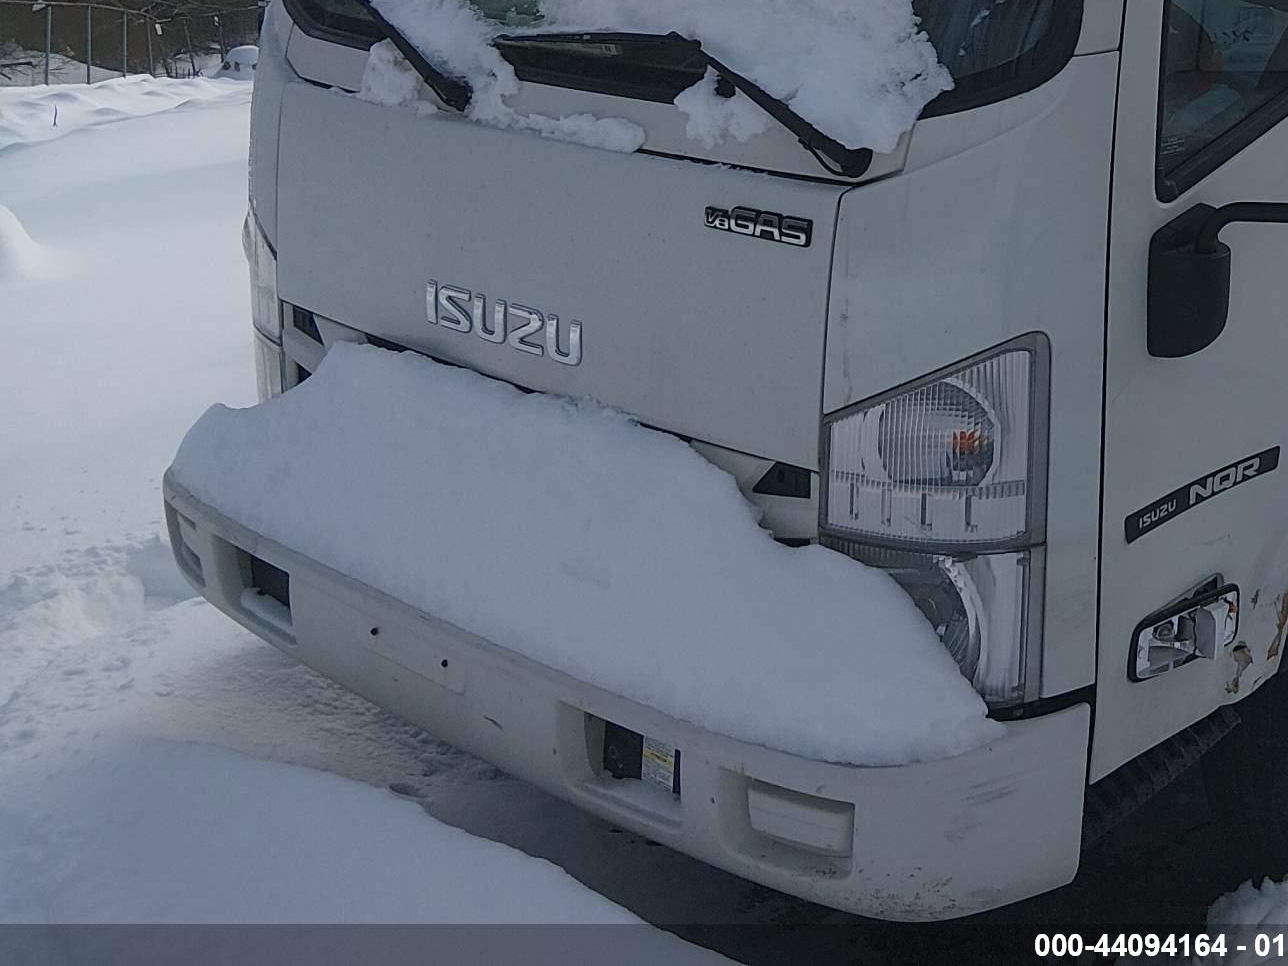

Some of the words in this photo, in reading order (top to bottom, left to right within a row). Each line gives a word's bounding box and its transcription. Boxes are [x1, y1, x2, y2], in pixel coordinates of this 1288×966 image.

[729, 207, 810, 247] GAS
[426, 279, 583, 367] ISUZU
[1138, 499, 1177, 530] ISUZU
[1189, 457, 1261, 506] NQR
